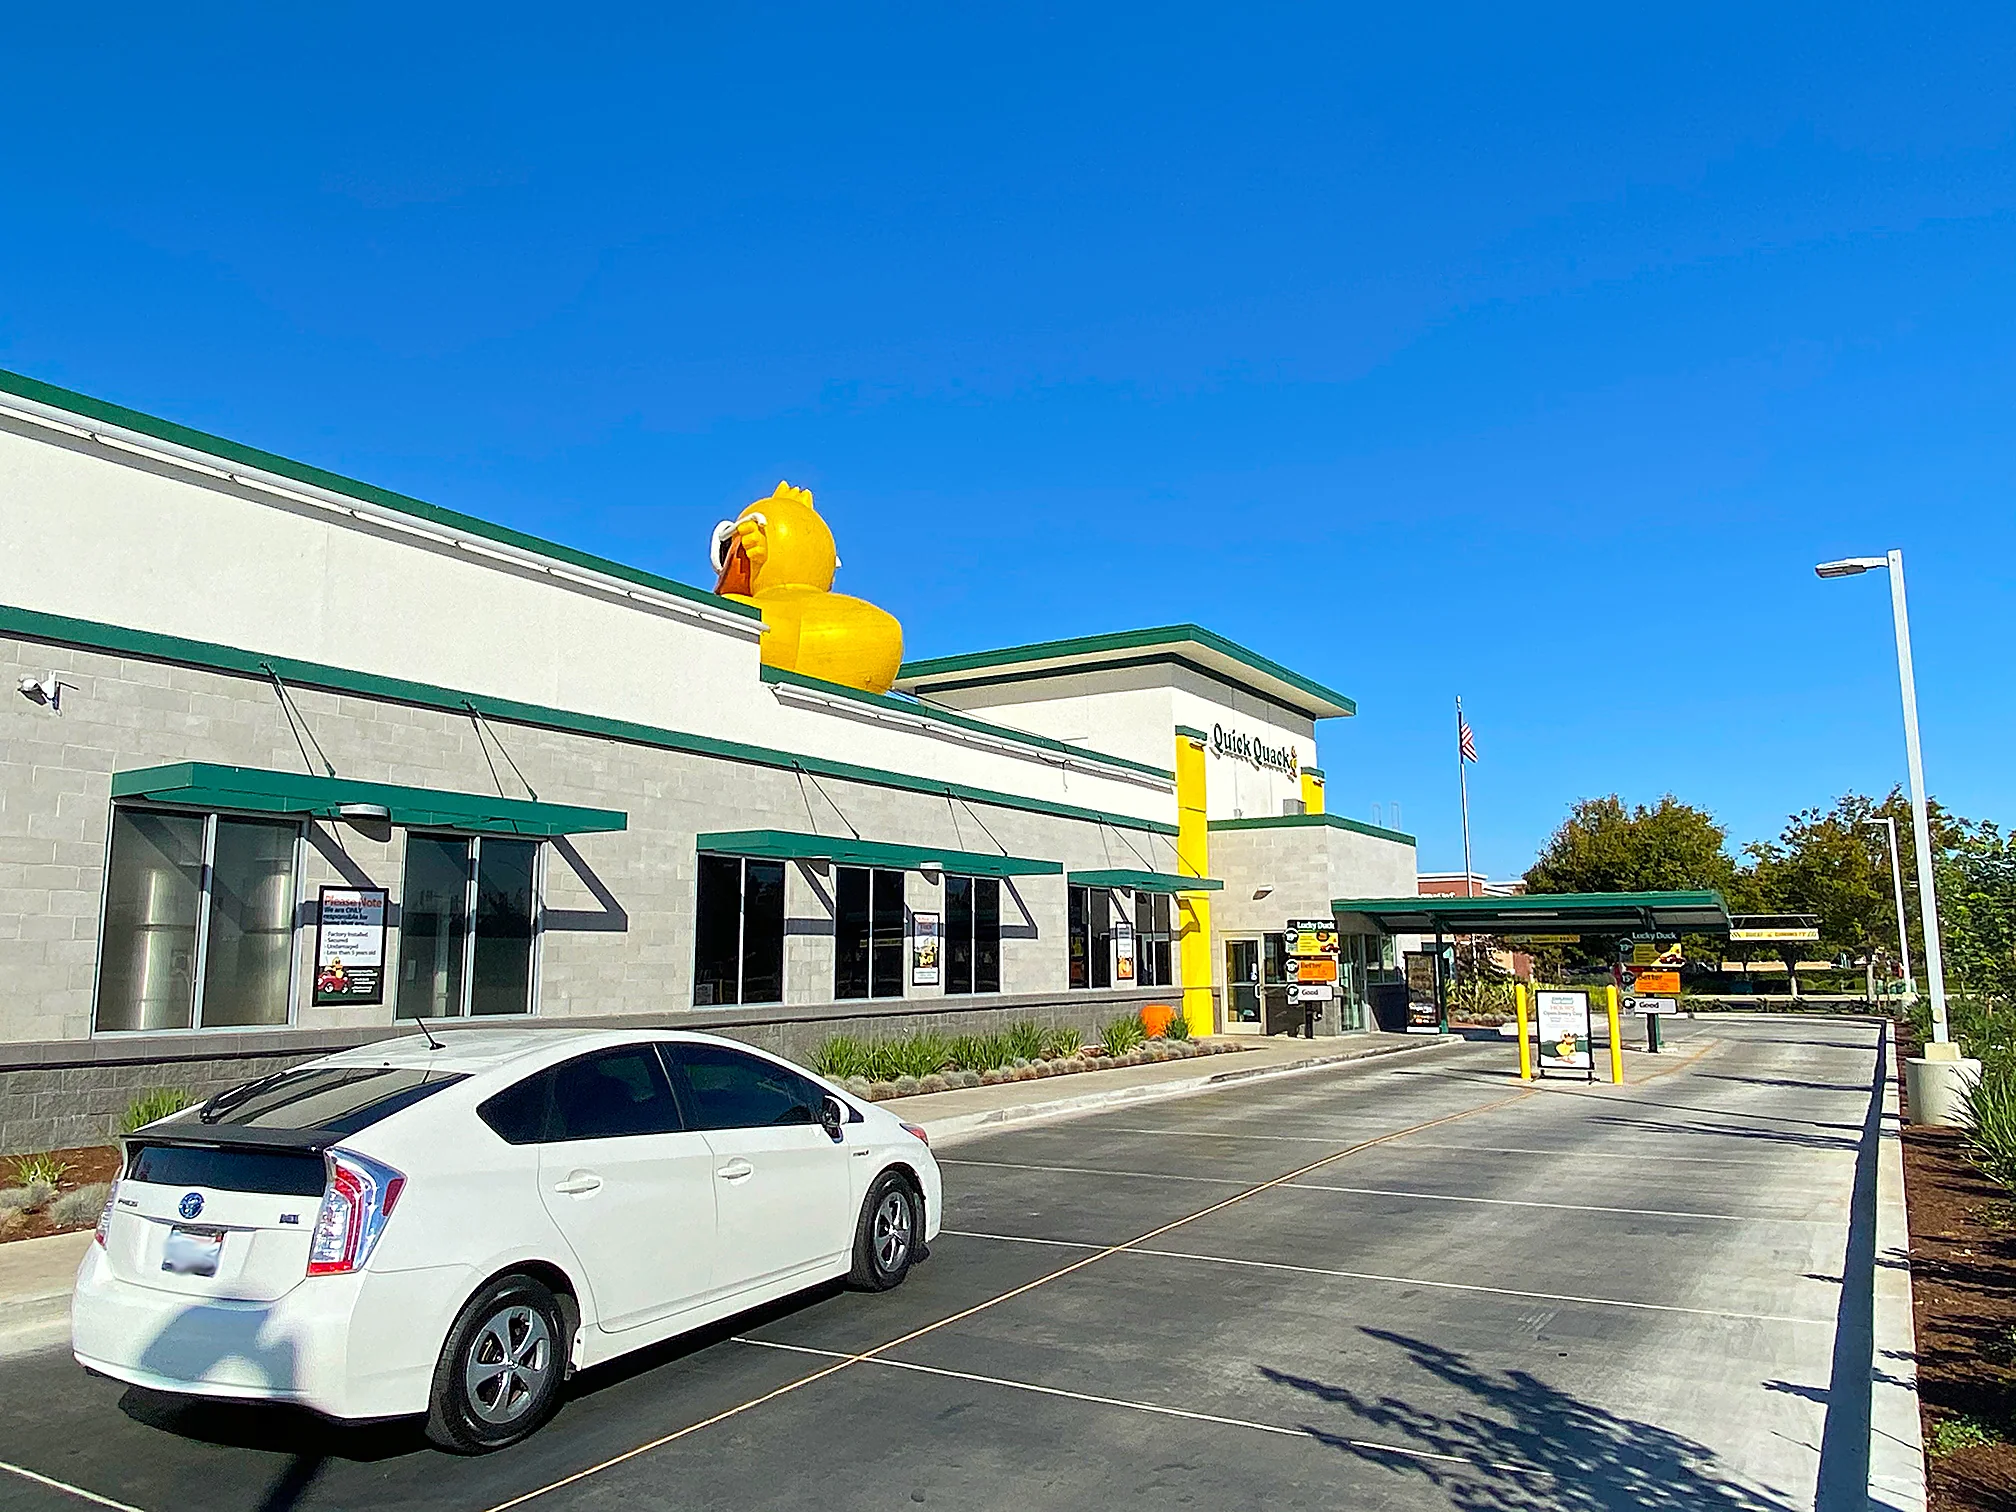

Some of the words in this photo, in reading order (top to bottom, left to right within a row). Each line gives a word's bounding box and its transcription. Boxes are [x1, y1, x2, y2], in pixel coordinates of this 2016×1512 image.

[1213, 723, 1252, 757] Quick
[1253, 737, 1291, 769] Quack
[325, 895, 358, 907] Please
[360, 896, 382, 908] Note
[1297, 921, 1316, 931] Lucky
[1317, 921, 1335, 930] Duck
[1632, 932, 1656, 941] Lucky
[1656, 932, 1678, 940] Duck
[1301, 988, 1319, 996] Good
[1639, 1001, 1660, 1009] Good
